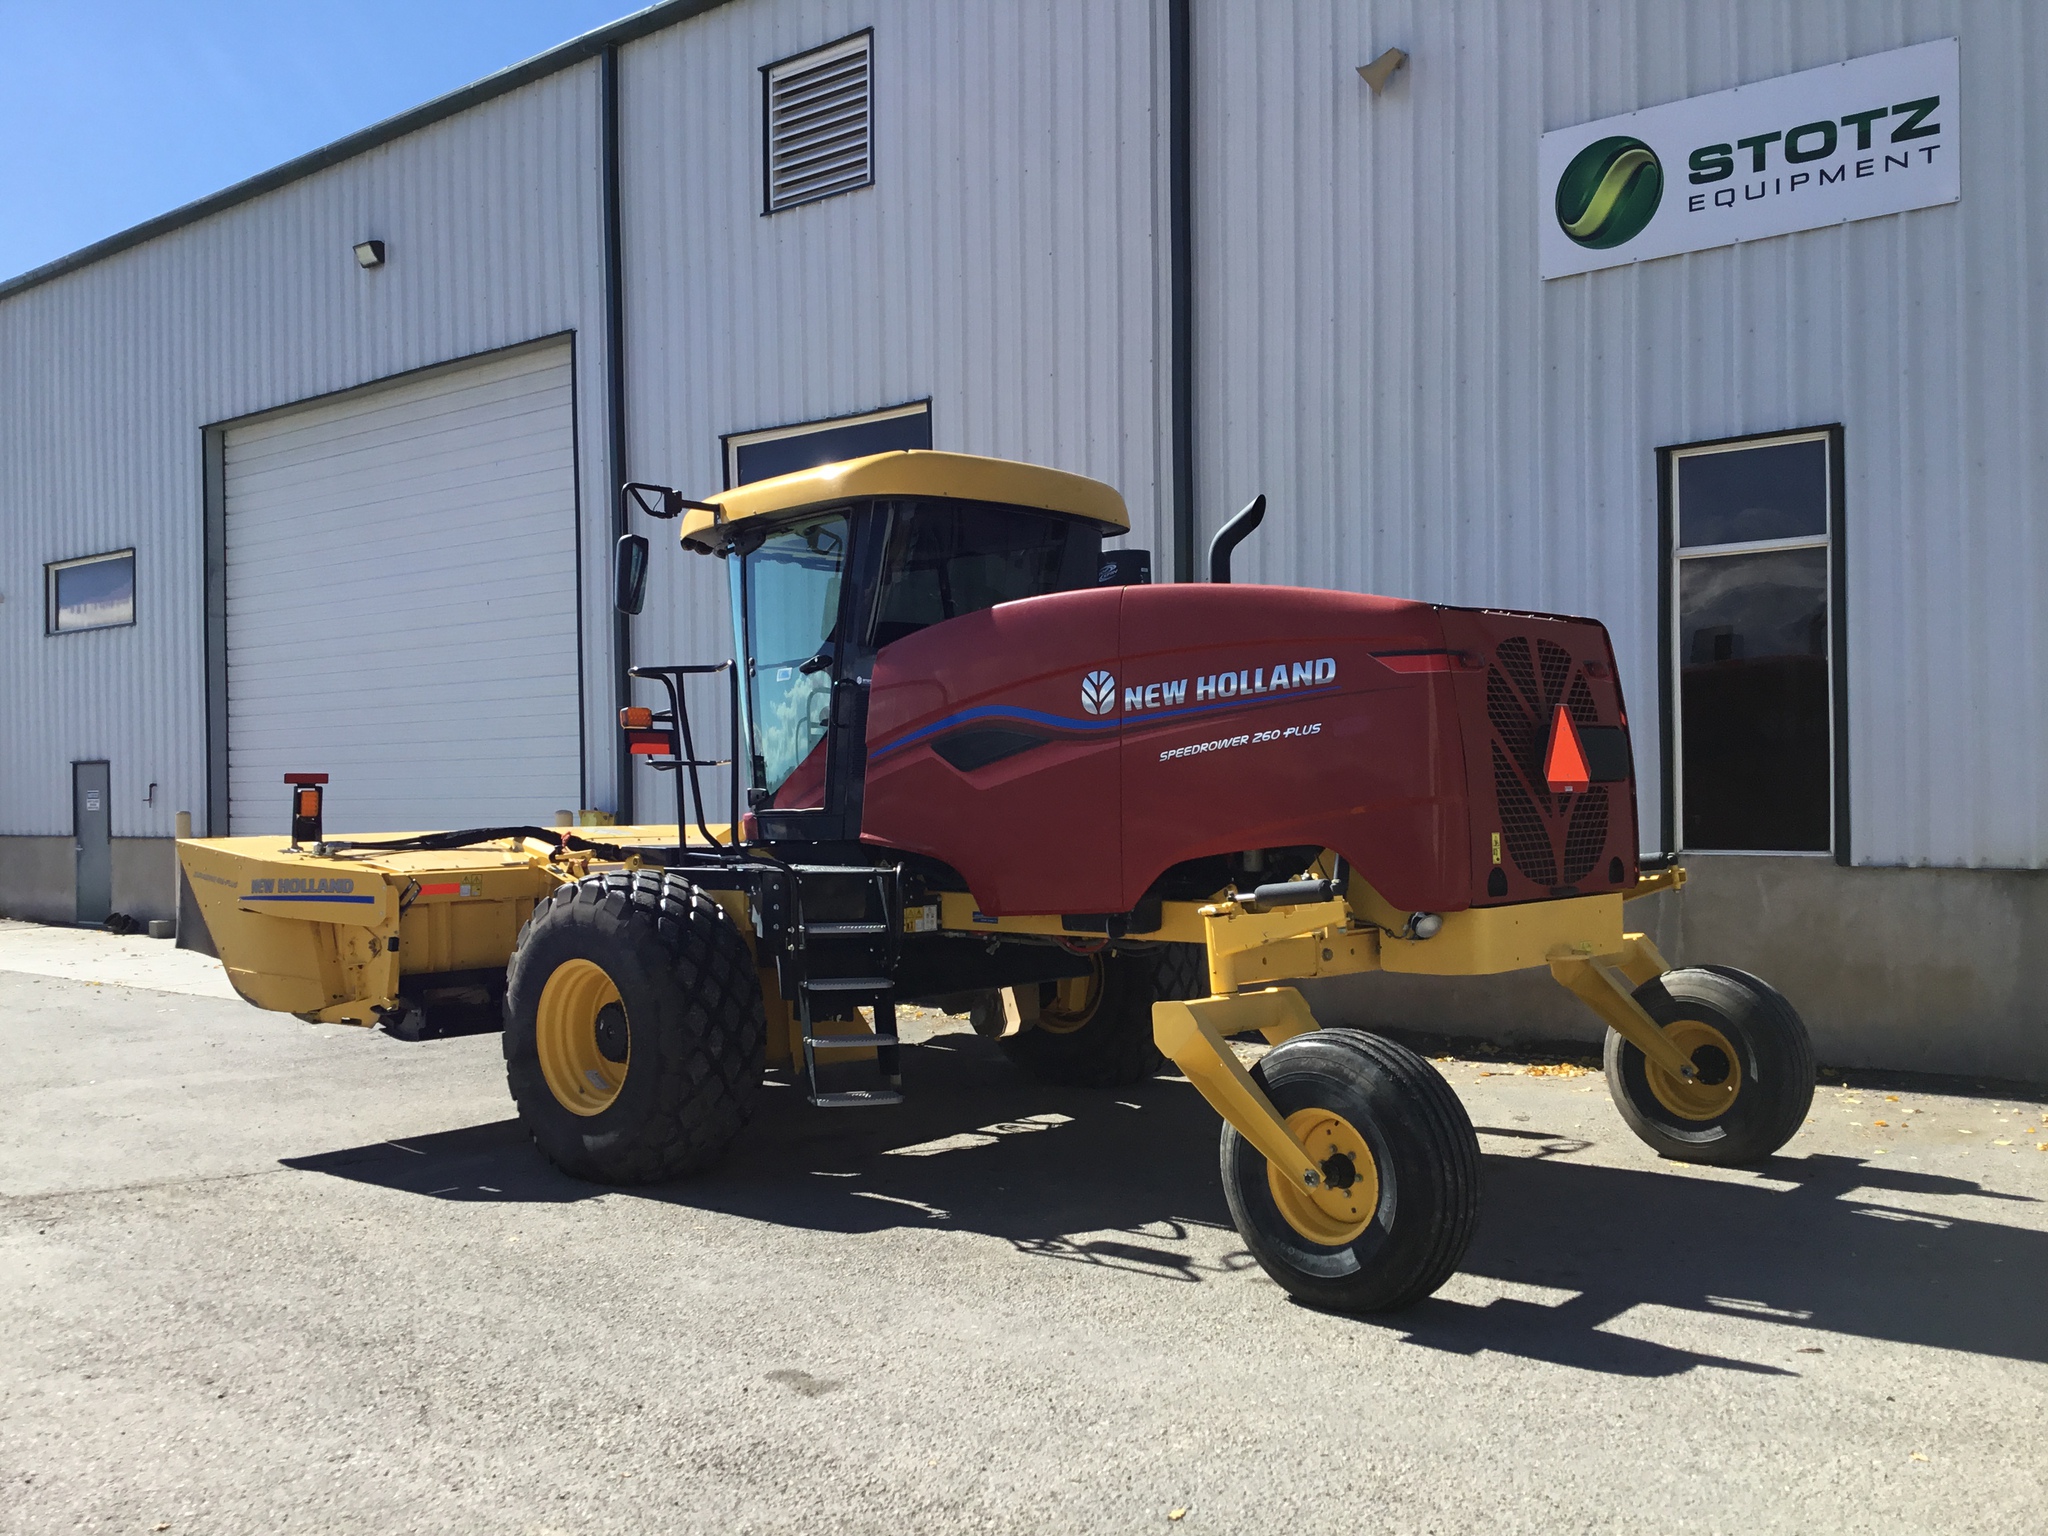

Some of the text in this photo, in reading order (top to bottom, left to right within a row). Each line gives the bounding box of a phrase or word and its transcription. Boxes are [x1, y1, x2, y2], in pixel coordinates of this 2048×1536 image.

[1688, 95, 1941, 185] STOTZ
[1688, 145, 1941, 212] EQUIPMENT
[1124, 657, 1336, 712] NEW HOLLAND
[1159, 734, 1249, 762] SPEEDROWER
[1252, 729, 1281, 744] 260
[251, 879, 275, 893] NEW
[278, 878, 354, 893] HOLLAND
